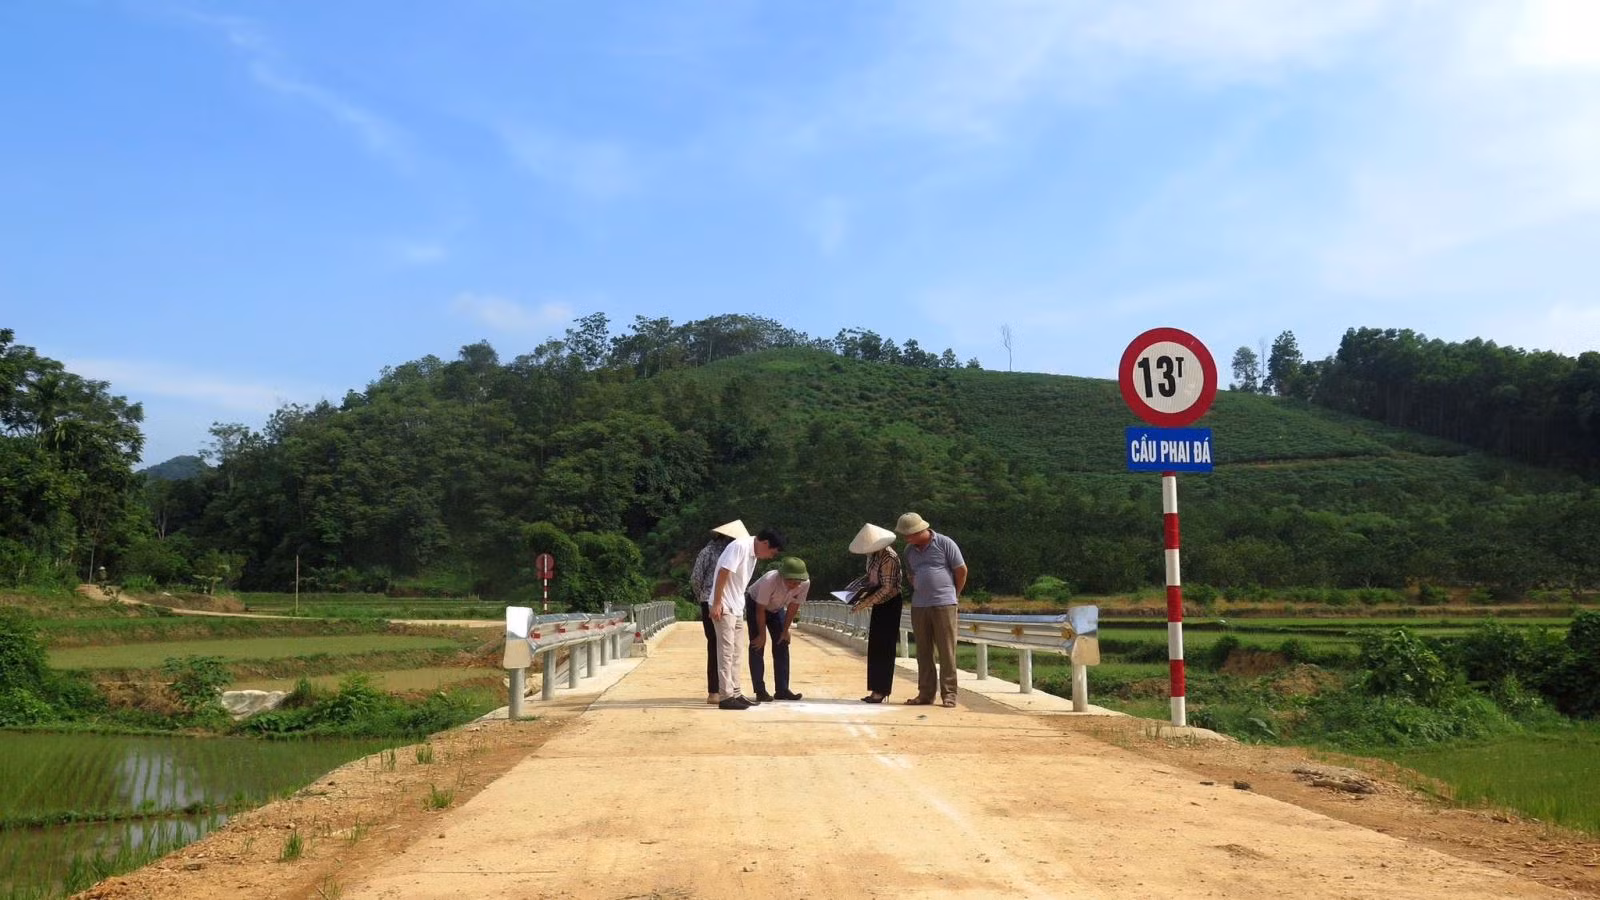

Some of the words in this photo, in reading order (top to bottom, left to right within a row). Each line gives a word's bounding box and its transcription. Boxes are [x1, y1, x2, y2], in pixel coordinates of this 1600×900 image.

[1131, 433, 1156, 463] CẦU
[1160, 440, 1190, 463] PHAI
[1193, 436, 1211, 463] ĐÁ
